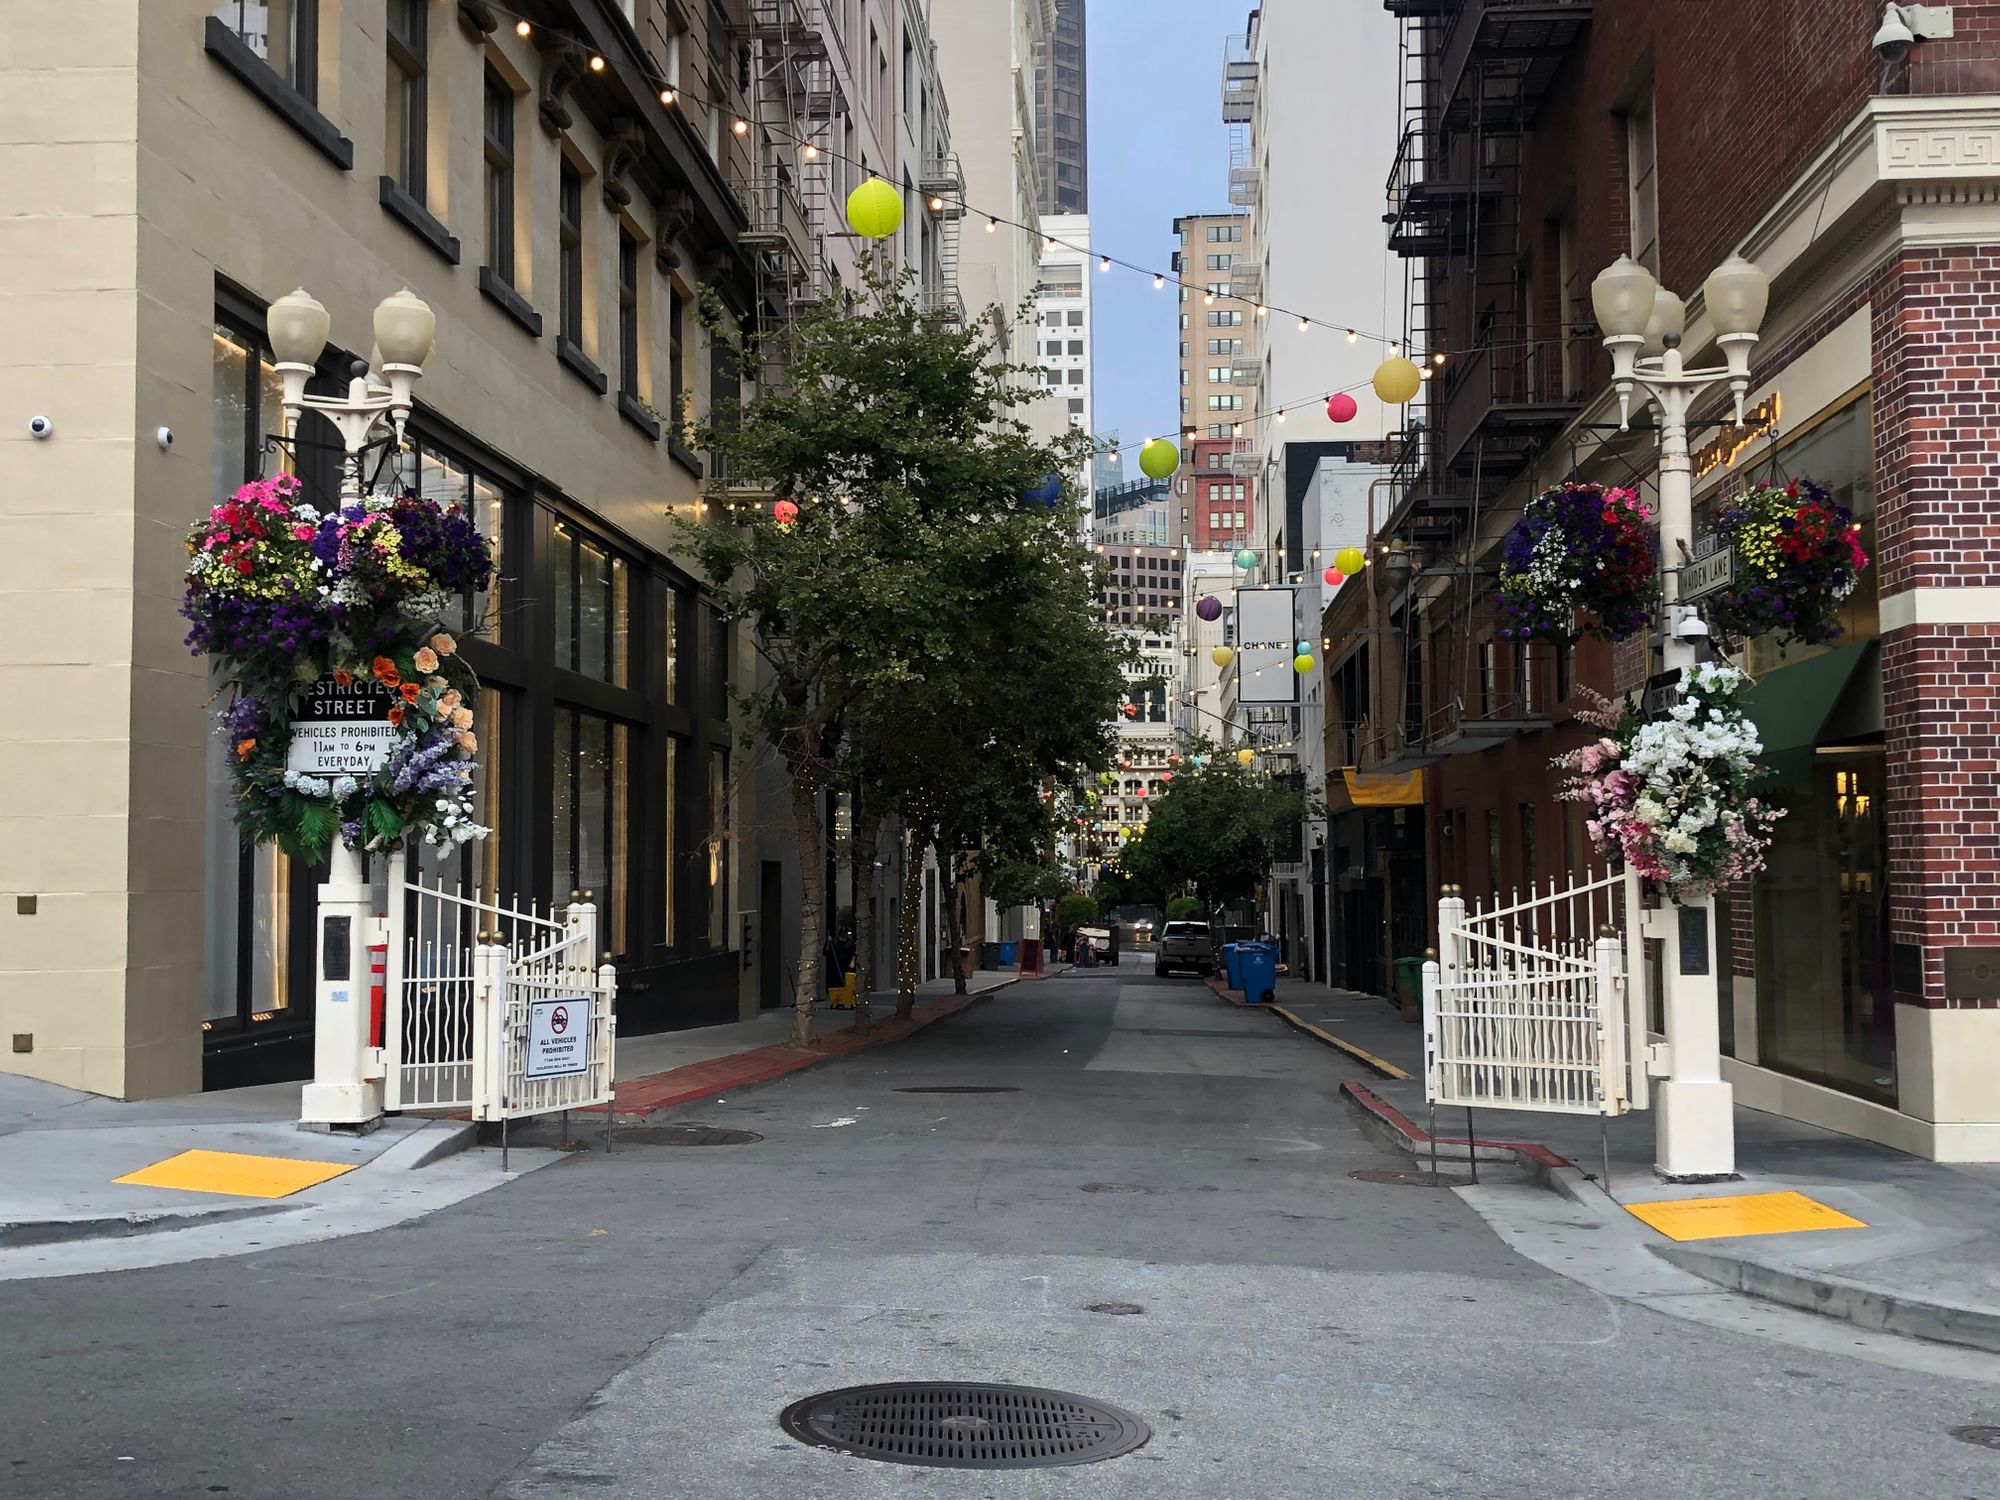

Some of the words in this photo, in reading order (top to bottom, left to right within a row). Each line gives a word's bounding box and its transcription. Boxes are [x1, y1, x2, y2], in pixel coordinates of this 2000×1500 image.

[1710, 556, 1728, 582] LANE
[1244, 641, 1288, 650] CHANE
[314, 701, 376, 714] STREET
[293, 727, 336, 738] VEHICLES
[341, 726, 397, 737] PROHIBITED
[340, 743, 350, 751] TO
[318, 756, 370, 767] EVERYDAY
[551, 1036, 576, 1044] VEHICLES
[542, 1045, 573, 1053] PROHIBITED
